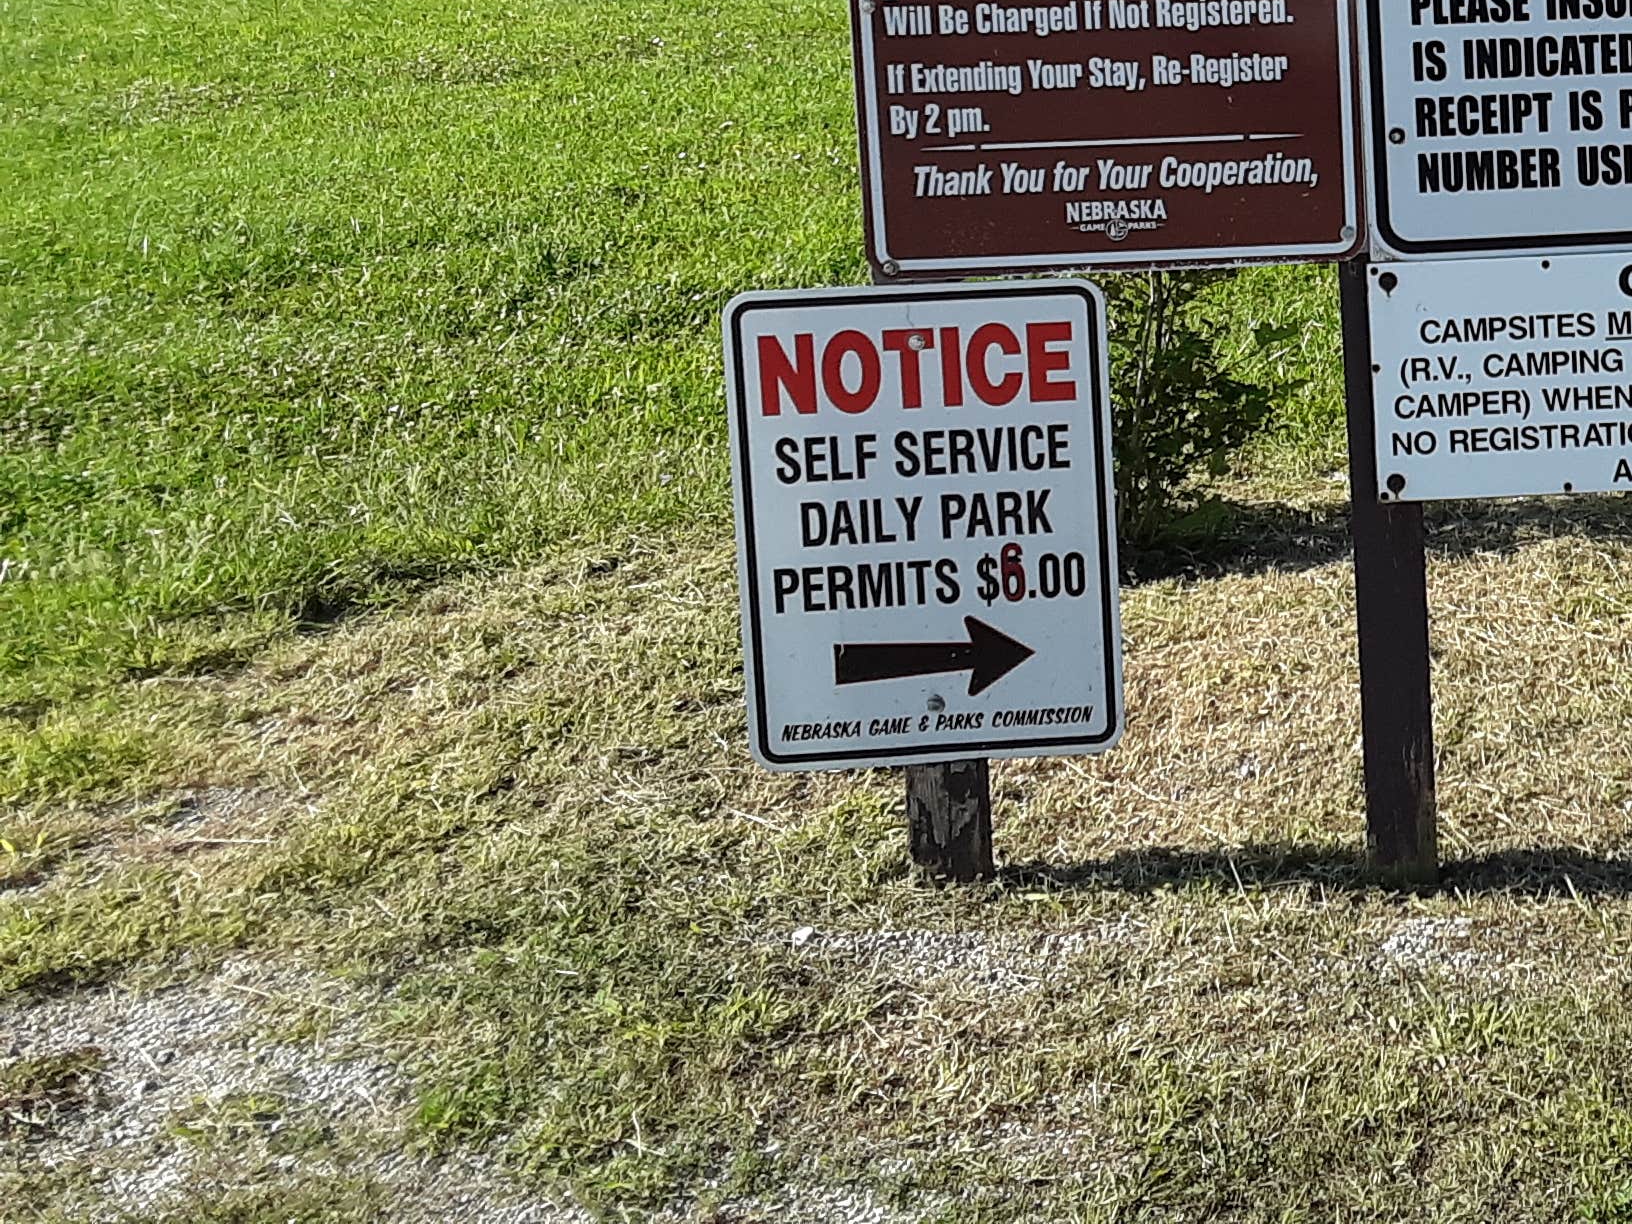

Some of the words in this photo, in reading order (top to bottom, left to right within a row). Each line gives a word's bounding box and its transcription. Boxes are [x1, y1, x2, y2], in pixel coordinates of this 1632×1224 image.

[883, 5, 932, 36] Will
[938, 5, 969, 35] Be
[976, 0, 1077, 36] Charged
[1084, 0, 1101, 30] If
[1109, 0, 1150, 29] Not
[887, 64, 904, 94] If
[911, 61, 1022, 95] Extending
[1027, 59, 1082, 90] Your
[1089, 57, 1146, 91] Stay,
[1152, 52, 1287, 87] Re-Register
[1413, 40, 1447, 81] IS
[890, 105, 918, 139] By
[925, 104, 941, 134] 2
[947, 107, 990, 137] pm.
[1416, 93, 1552, 137] RECEIPT
[1569, 91, 1602, 131] IS
[914, 164, 992, 197] Thank
[1000, 162, 1043, 194] You
[1053, 160, 1088, 192] for
[1097, 157, 1152, 190] Your
[1159, 154, 1319, 193] Cooperation,
[1418, 148, 1560, 193] NUMBER
[1066, 199, 1168, 223] NEBRASKA
[1420, 312, 1596, 344] CAMPSITES
[757, 321, 1077, 416] NOTICE
[1400, 356, 1472, 388] (R.V.,
[1483, 348, 1623, 378] CAMPING
[1394, 390, 1531, 420] CAMPER)
[775, 434, 877, 484] SELF
[894, 424, 1071, 477] SERVICE
[1392, 431, 1436, 456] NO
[801, 496, 922, 547] DAILY
[941, 489, 1053, 539] PARK
[773, 559, 960, 614] PERMITS
[977, 542, 1085, 607] $6.00
[781, 721, 861, 741] NEBRASKA
[868, 717, 911, 735] GAME
[919, 716, 930, 731] &
[936, 713, 984, 731] PARKS
[992, 706, 1094, 728] COMMISSION
